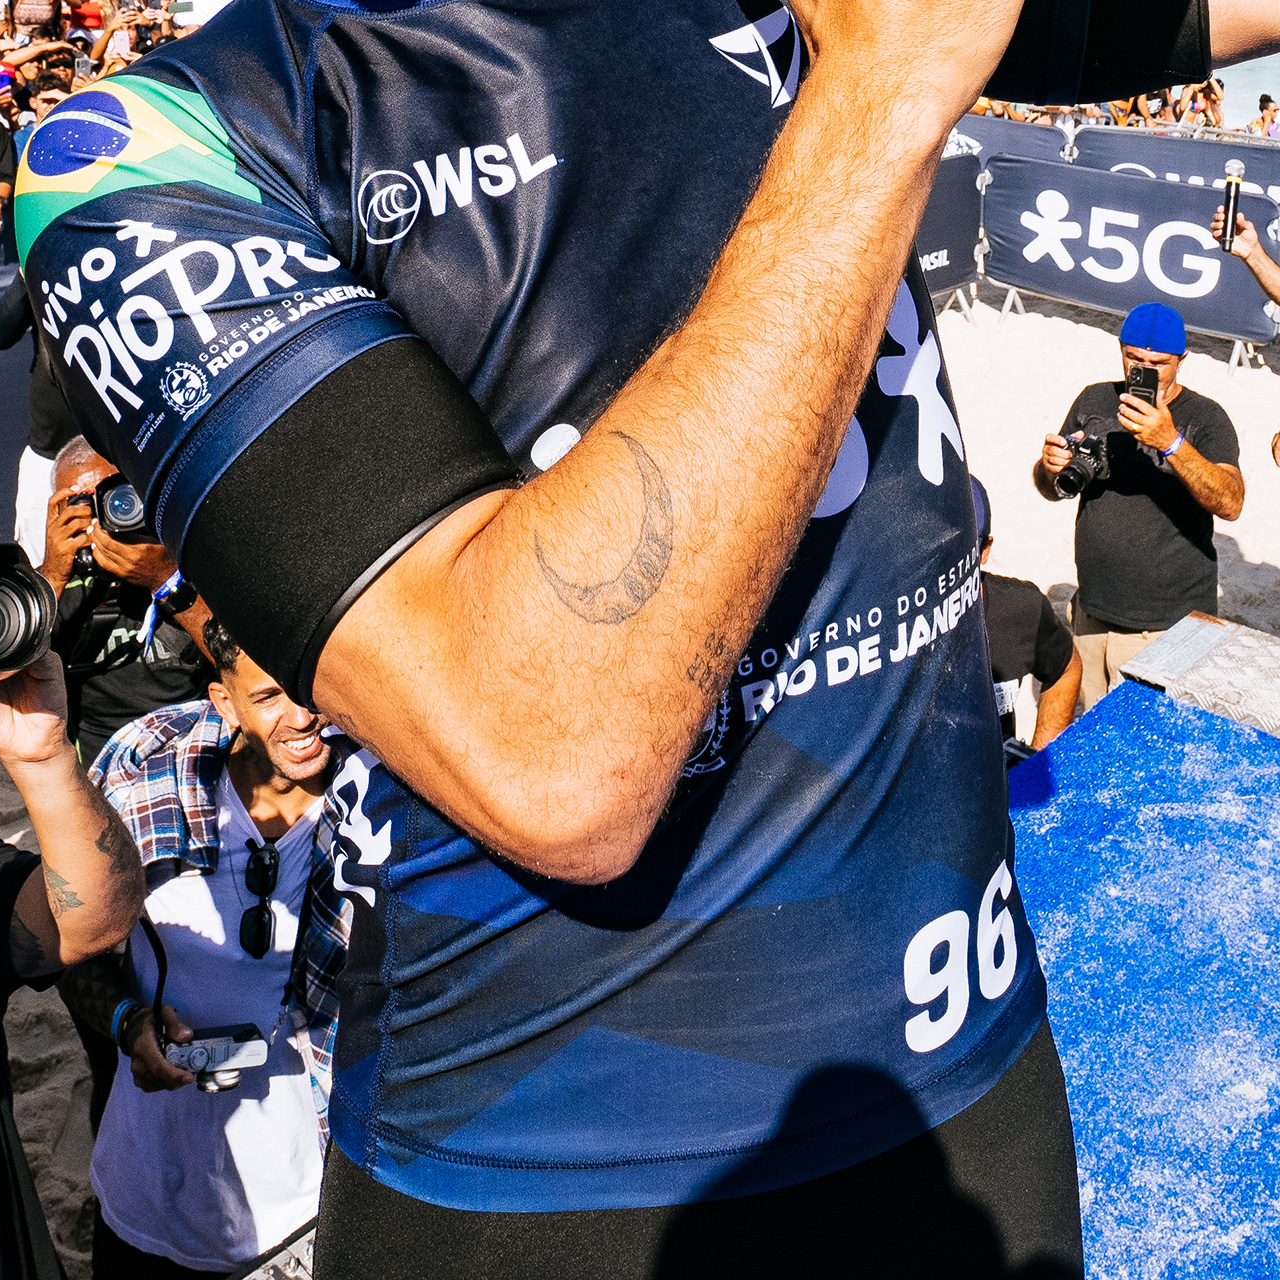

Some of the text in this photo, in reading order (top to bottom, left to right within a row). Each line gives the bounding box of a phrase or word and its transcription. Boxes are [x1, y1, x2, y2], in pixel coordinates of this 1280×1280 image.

[413, 132, 558, 216] WSL
[42, 247, 117, 339] vivo
[919, 249, 951, 272] ASIL
[1080, 206, 1222, 299] 5G
[198, 292, 305, 363] GOVERNO DO
[206, 339, 250, 377] RIO
[251, 316, 286, 345] DE
[737, 606, 883, 677] GOVERNO
[897, 586, 927, 616] DO
[740, 658, 817, 722] RIO
[825, 633, 882, 687] DE
[903, 858, 1018, 1054] 96
